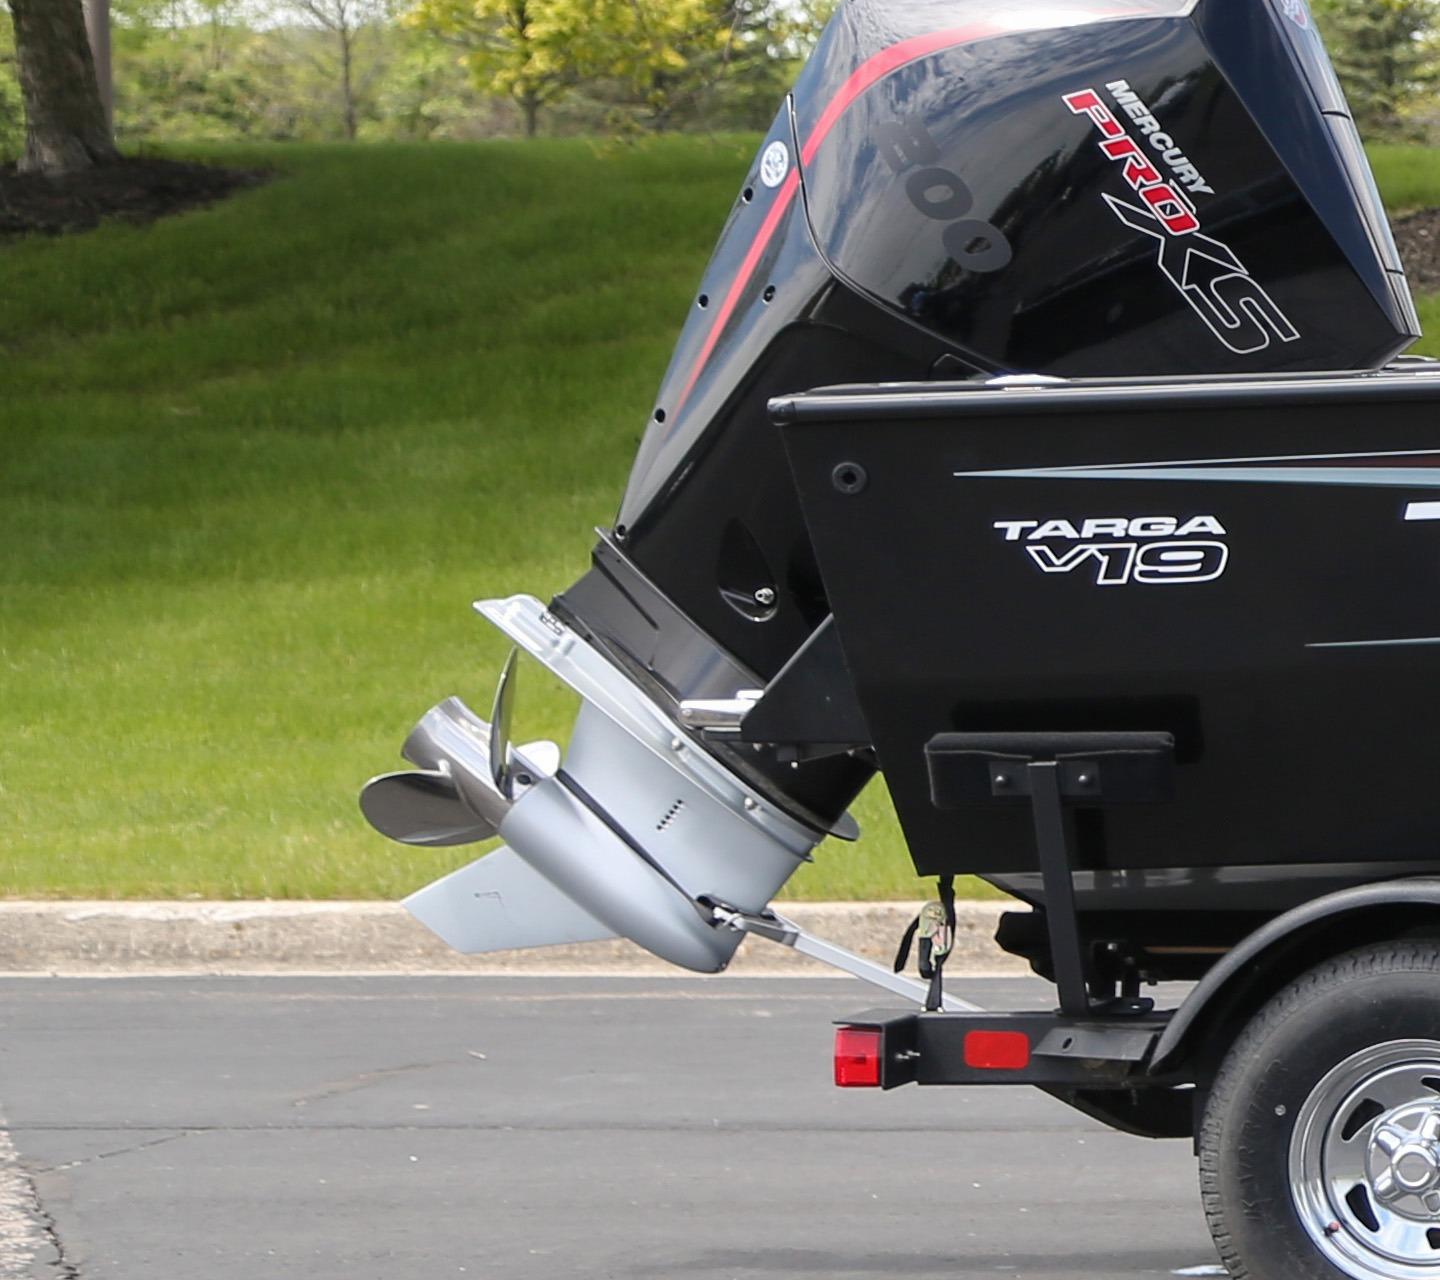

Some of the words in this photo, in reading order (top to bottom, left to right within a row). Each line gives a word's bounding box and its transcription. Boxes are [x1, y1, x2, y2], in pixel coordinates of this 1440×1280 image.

[1061, 88, 1200, 235] PRO
[1105, 79, 1216, 195] MERCURY
[877, 119, 1012, 273] 200
[993, 516, 1227, 540] TARGA
[1025, 540, 1229, 585] V19
